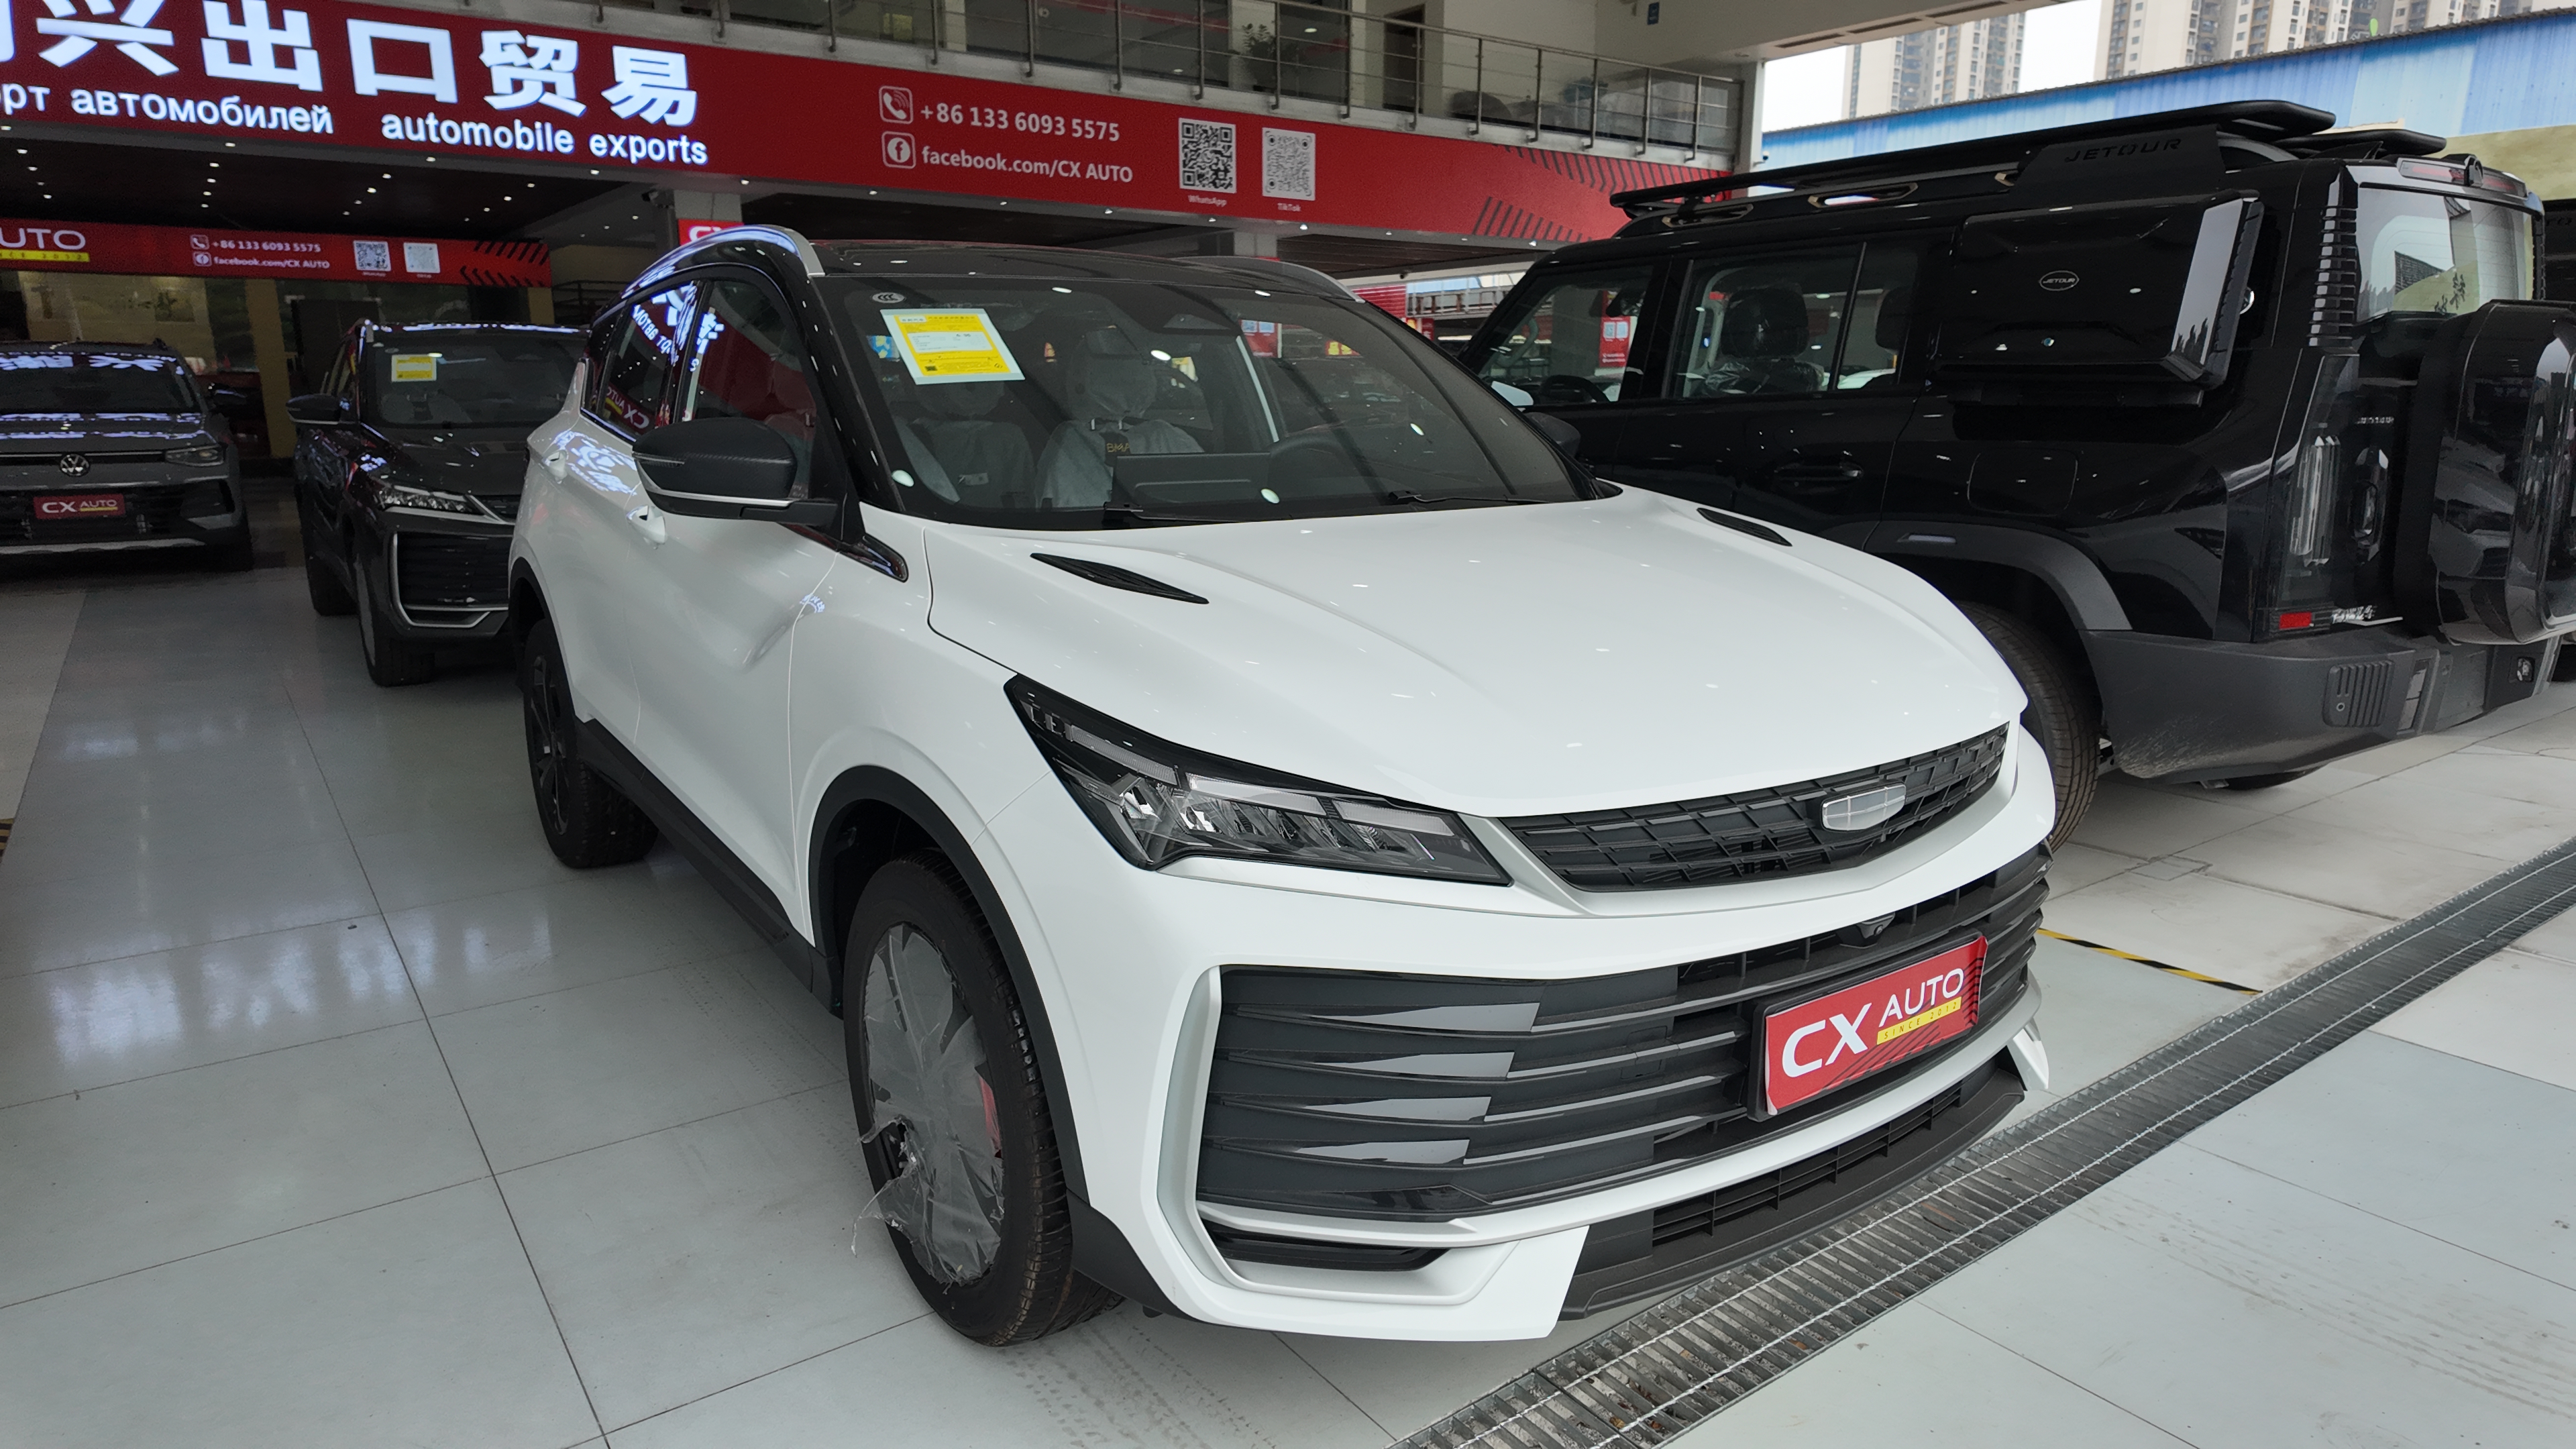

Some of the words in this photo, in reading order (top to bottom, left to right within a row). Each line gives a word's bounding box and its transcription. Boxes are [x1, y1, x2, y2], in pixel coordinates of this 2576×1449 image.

[0, 0, 698, 127] 兴出口贸易
[0, 83, 50, 115] рт
[70, 87, 334, 134] автомобилей
[920, 103, 964, 125] +86
[970, 106, 1009, 129] 133
[1014, 111, 1066, 136] 6093
[1071, 118, 1121, 142] 5575
[380, 111, 576, 154] automobile
[588, 133, 709, 165] exports
[2064, 138, 2182, 163] JETOUR
[922, 145, 1081, 178] facebook.com/CX
[1085, 163, 1134, 183] AUTO
[212, 239, 235, 249] +86
[237, 240, 260, 250] 133
[261, 241, 291, 252] 6093
[292, 243, 321, 253] 5575
[689, 225, 722, 242] C
[303, 259, 330, 269] AUTO
[42, 501, 78, 513] CX
[80, 499, 117, 508] AUTO
[1782, 1002, 1872, 1077] CX
[1878, 968, 1965, 1028] AUTO
[1883, 1018, 1921, 1040] SINCE
[1929, 1002, 1957, 1020] 2012
